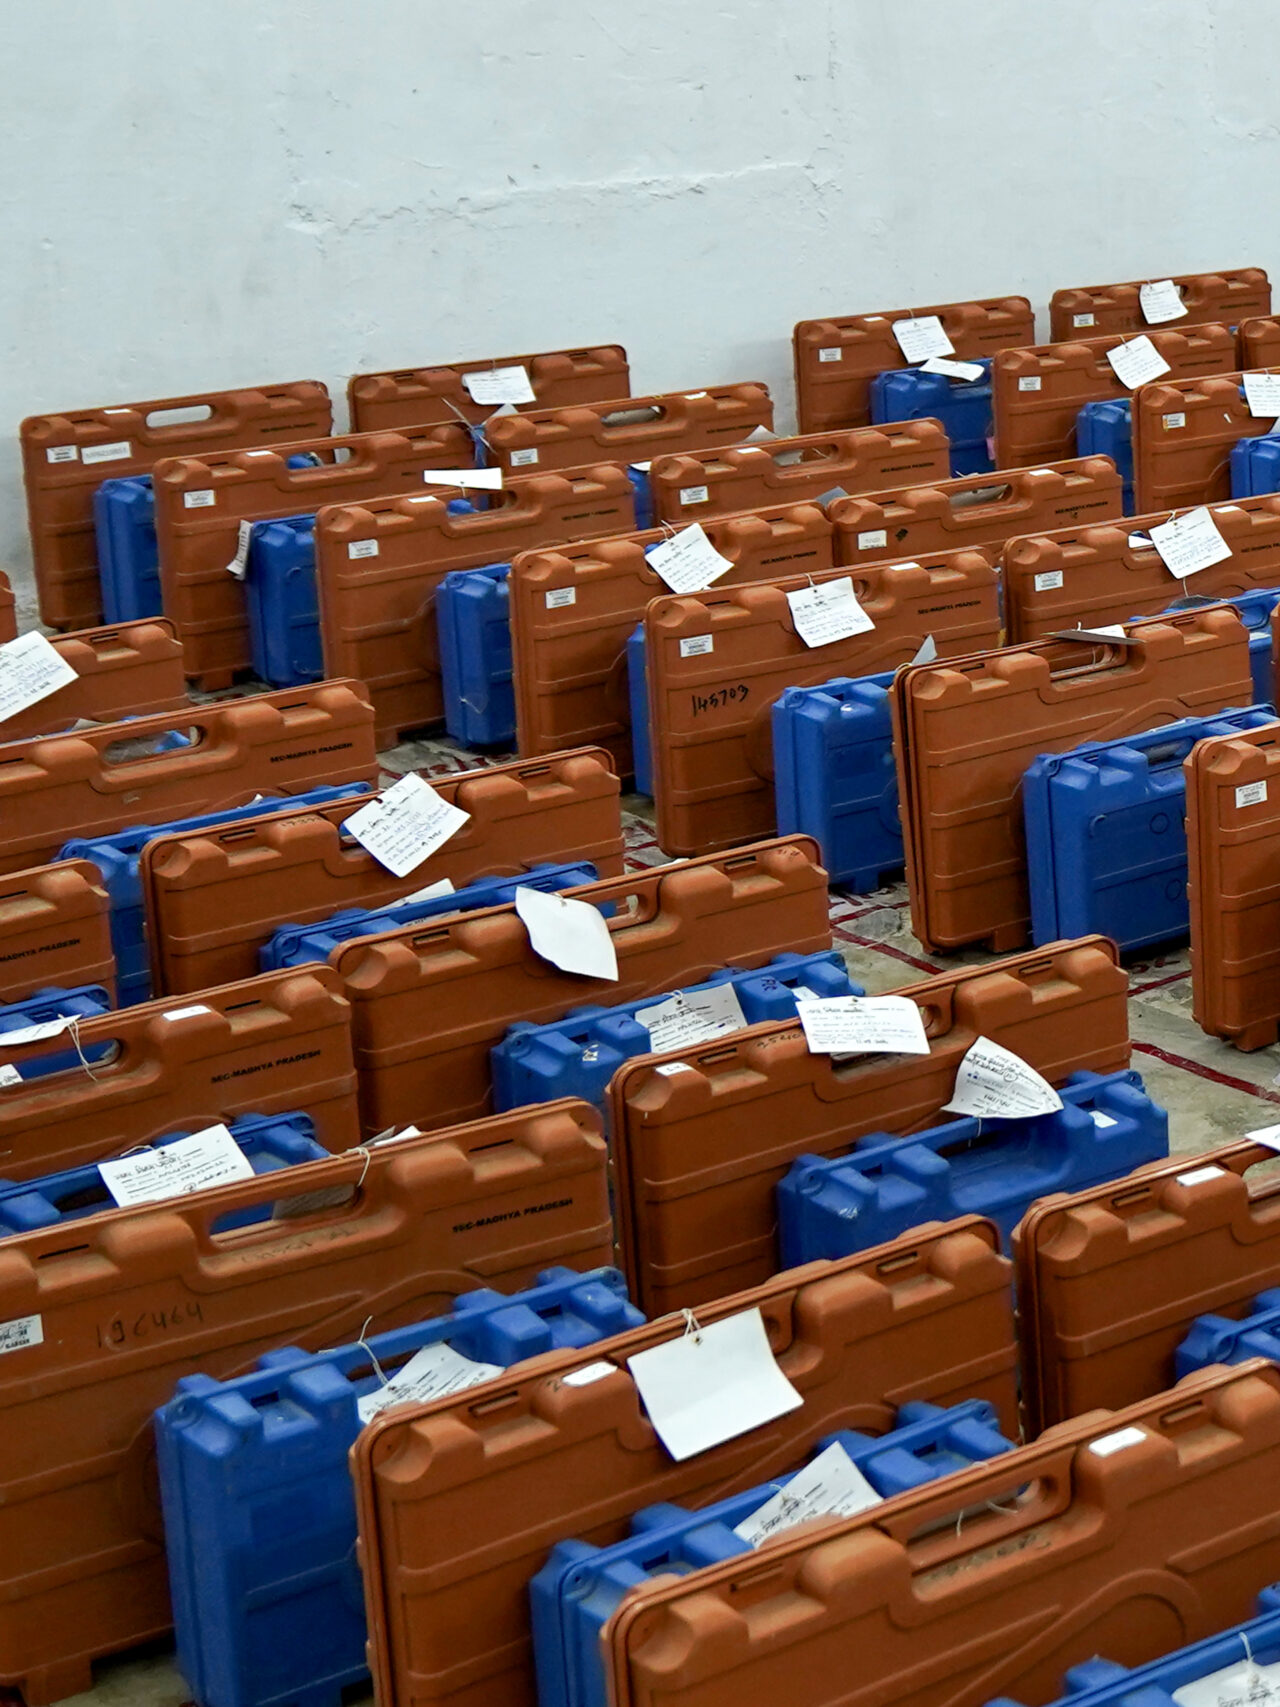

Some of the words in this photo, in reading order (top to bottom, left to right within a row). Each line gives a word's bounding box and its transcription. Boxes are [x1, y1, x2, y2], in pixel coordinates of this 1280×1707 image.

[270, 750, 317, 763] SEC-MADHYA
[318, 742, 354, 753] PRADESH
[38, 939, 81, 953] PRADESH
[211, 1062, 273, 1084] SEC-MADHYA
[275, 1050, 321, 1067] PRADESH
[453, 1210, 521, 1233] SEC-MADHYA
[523, 1197, 574, 1216] PRADESH
